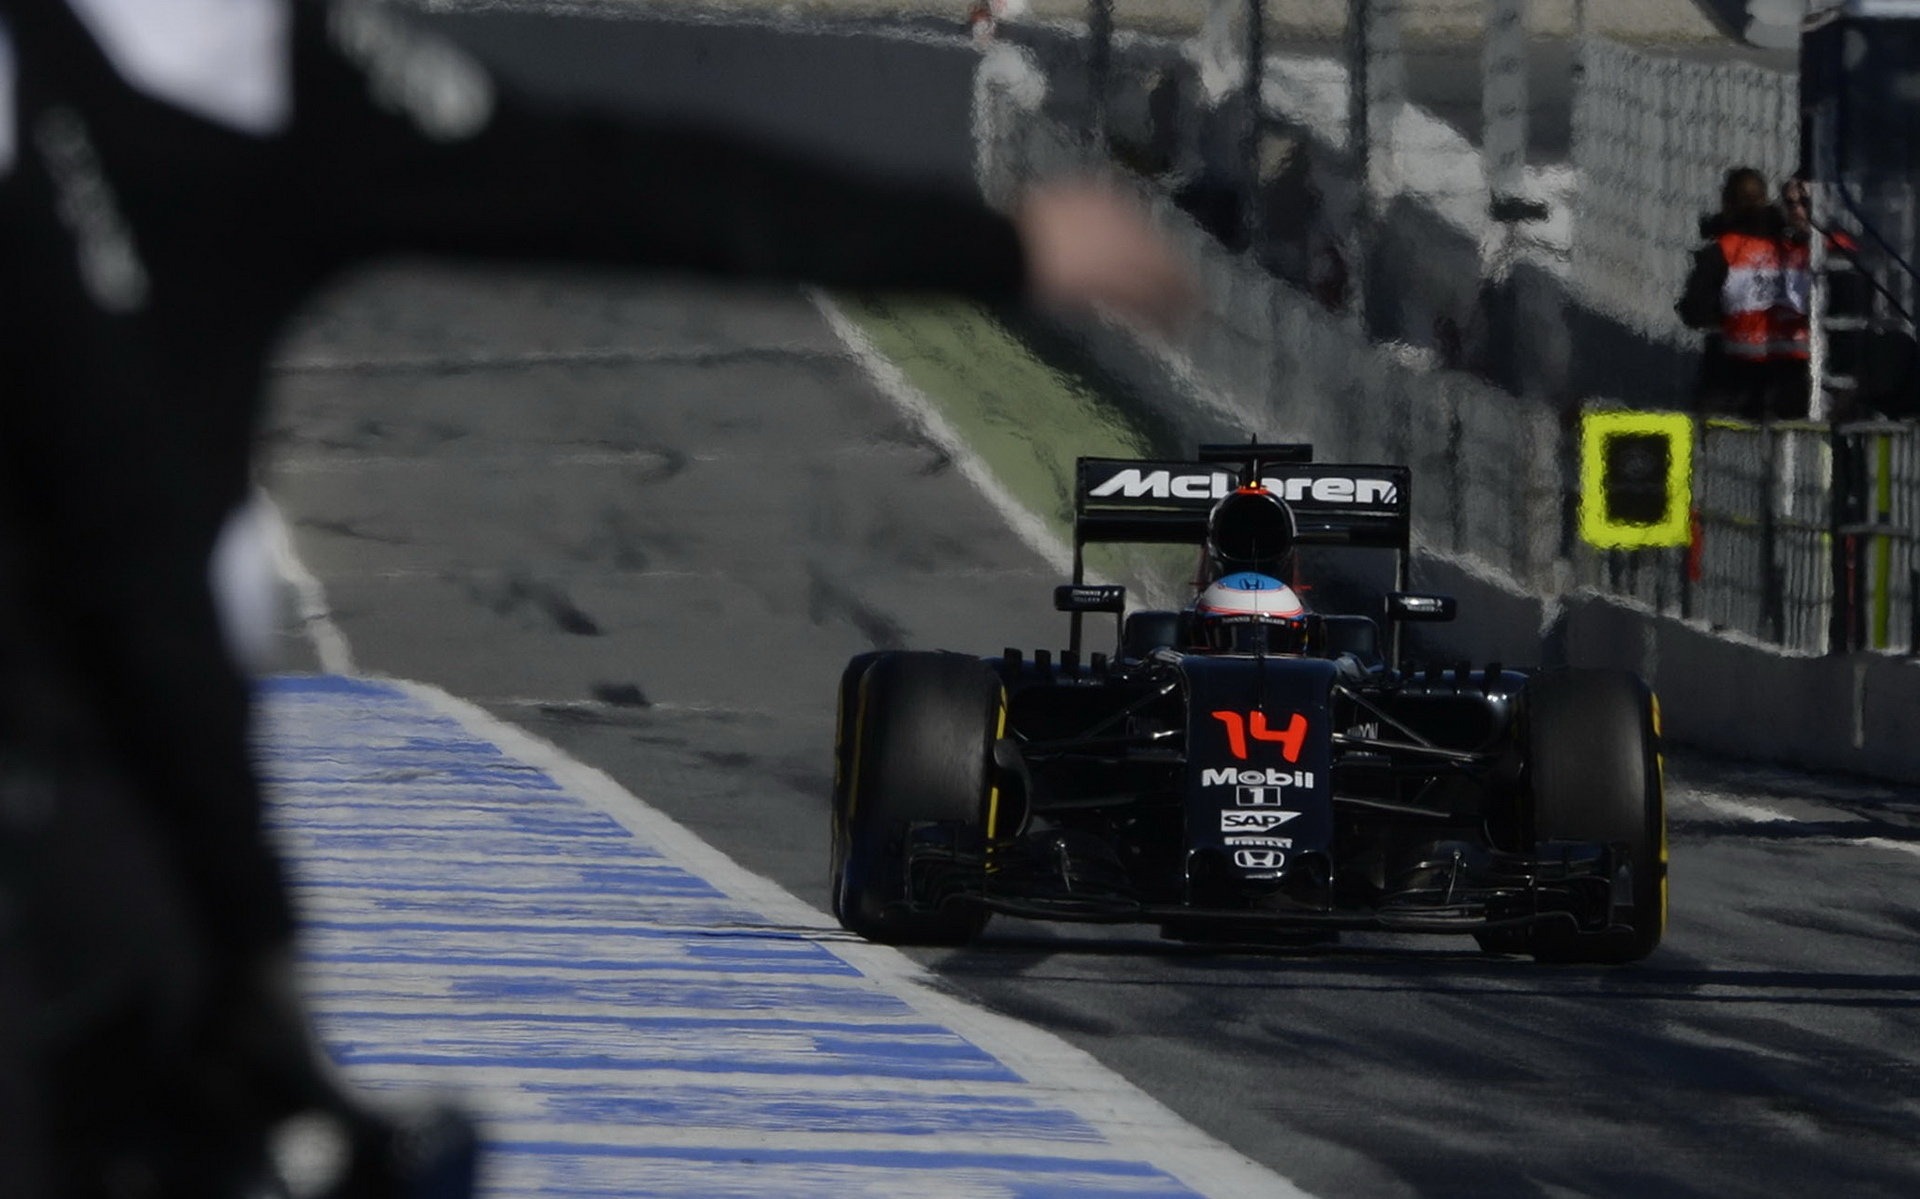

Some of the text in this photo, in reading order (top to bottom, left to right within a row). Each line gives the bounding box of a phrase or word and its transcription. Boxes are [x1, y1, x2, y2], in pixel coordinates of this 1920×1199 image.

[1211, 710, 1308, 763] 14
[1201, 767, 1314, 788] Mobil
[1224, 814, 1281, 828] SAP
